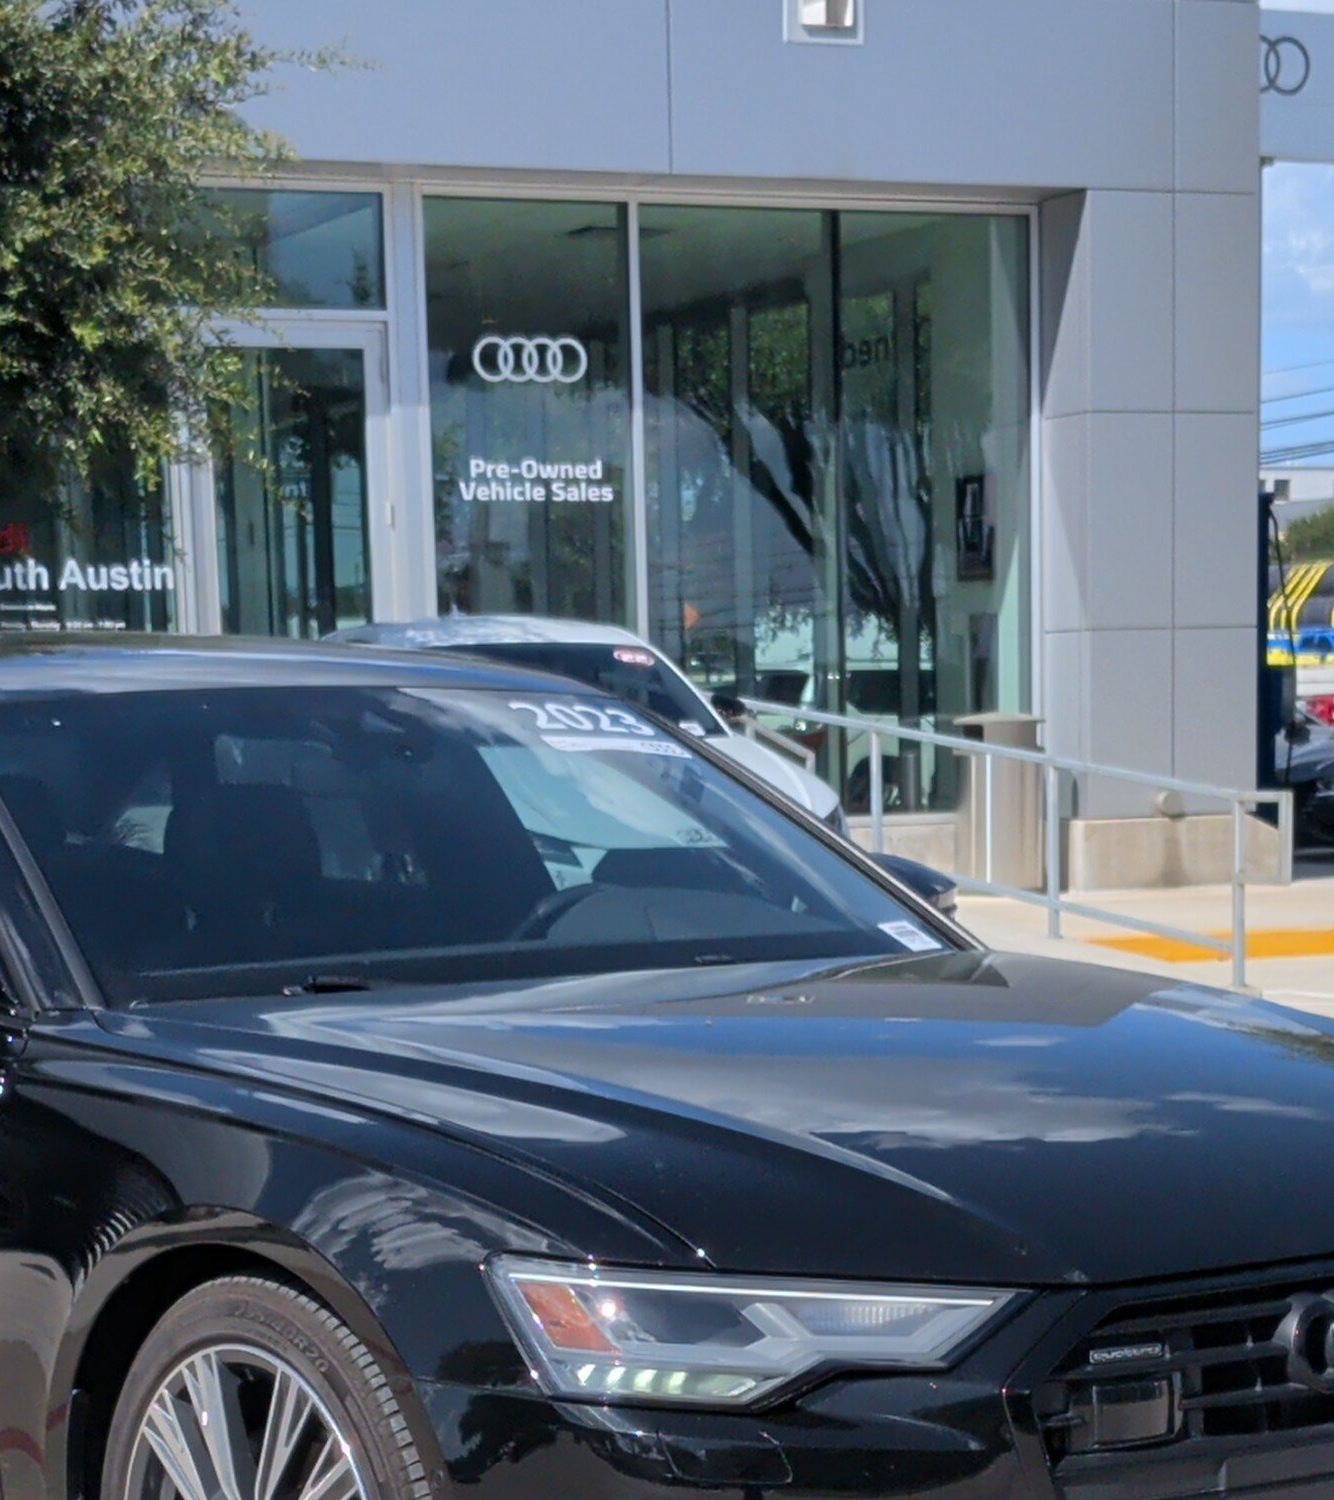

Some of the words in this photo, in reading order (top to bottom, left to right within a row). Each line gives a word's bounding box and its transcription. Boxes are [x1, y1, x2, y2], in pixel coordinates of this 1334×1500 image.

[469, 457, 603, 480] Pre-Owned
[459, 481, 546, 501] Vehicle
[551, 481, 614, 502] Sales
[58, 556, 175, 591] Austin
[508, 702, 656, 737] 2023
